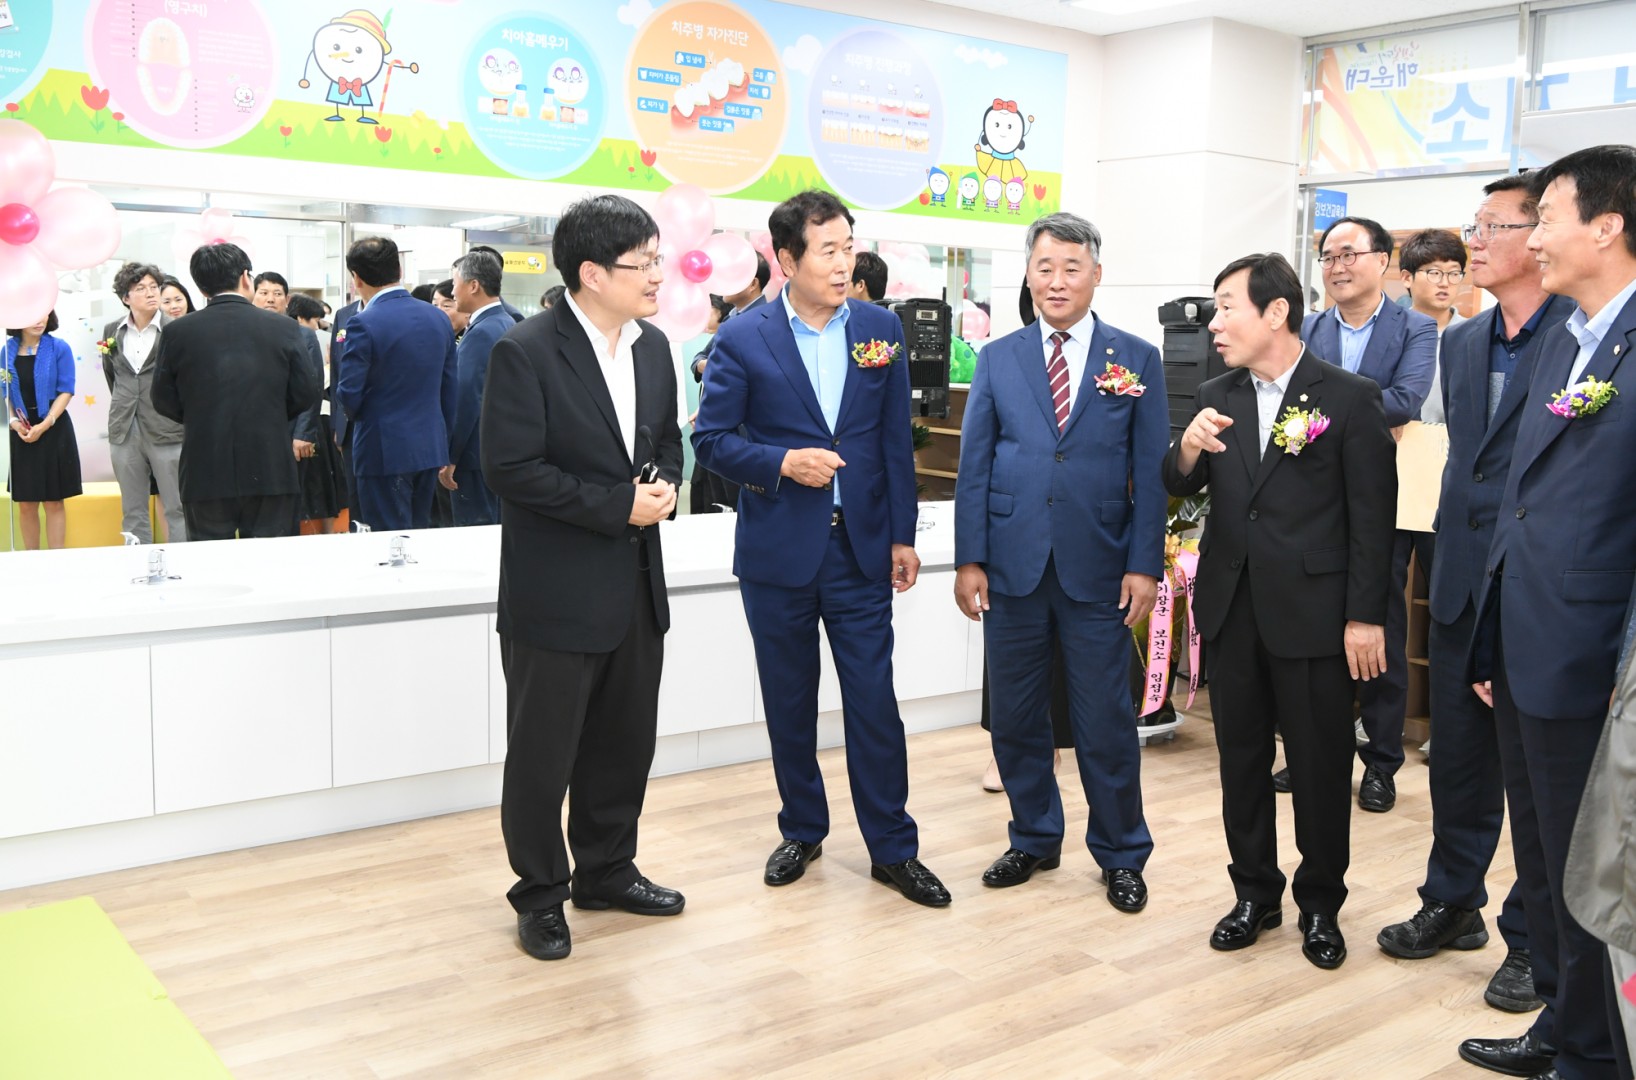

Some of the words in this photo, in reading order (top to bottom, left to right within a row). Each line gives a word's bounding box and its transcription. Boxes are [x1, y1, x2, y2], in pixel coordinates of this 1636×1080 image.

[501, 28, 569, 51] 치아홈메우기
[671, 20, 704, 39] 치주병
[706, 26, 750, 47] 자가진단
[1152, 629, 1168, 661] 보건소
